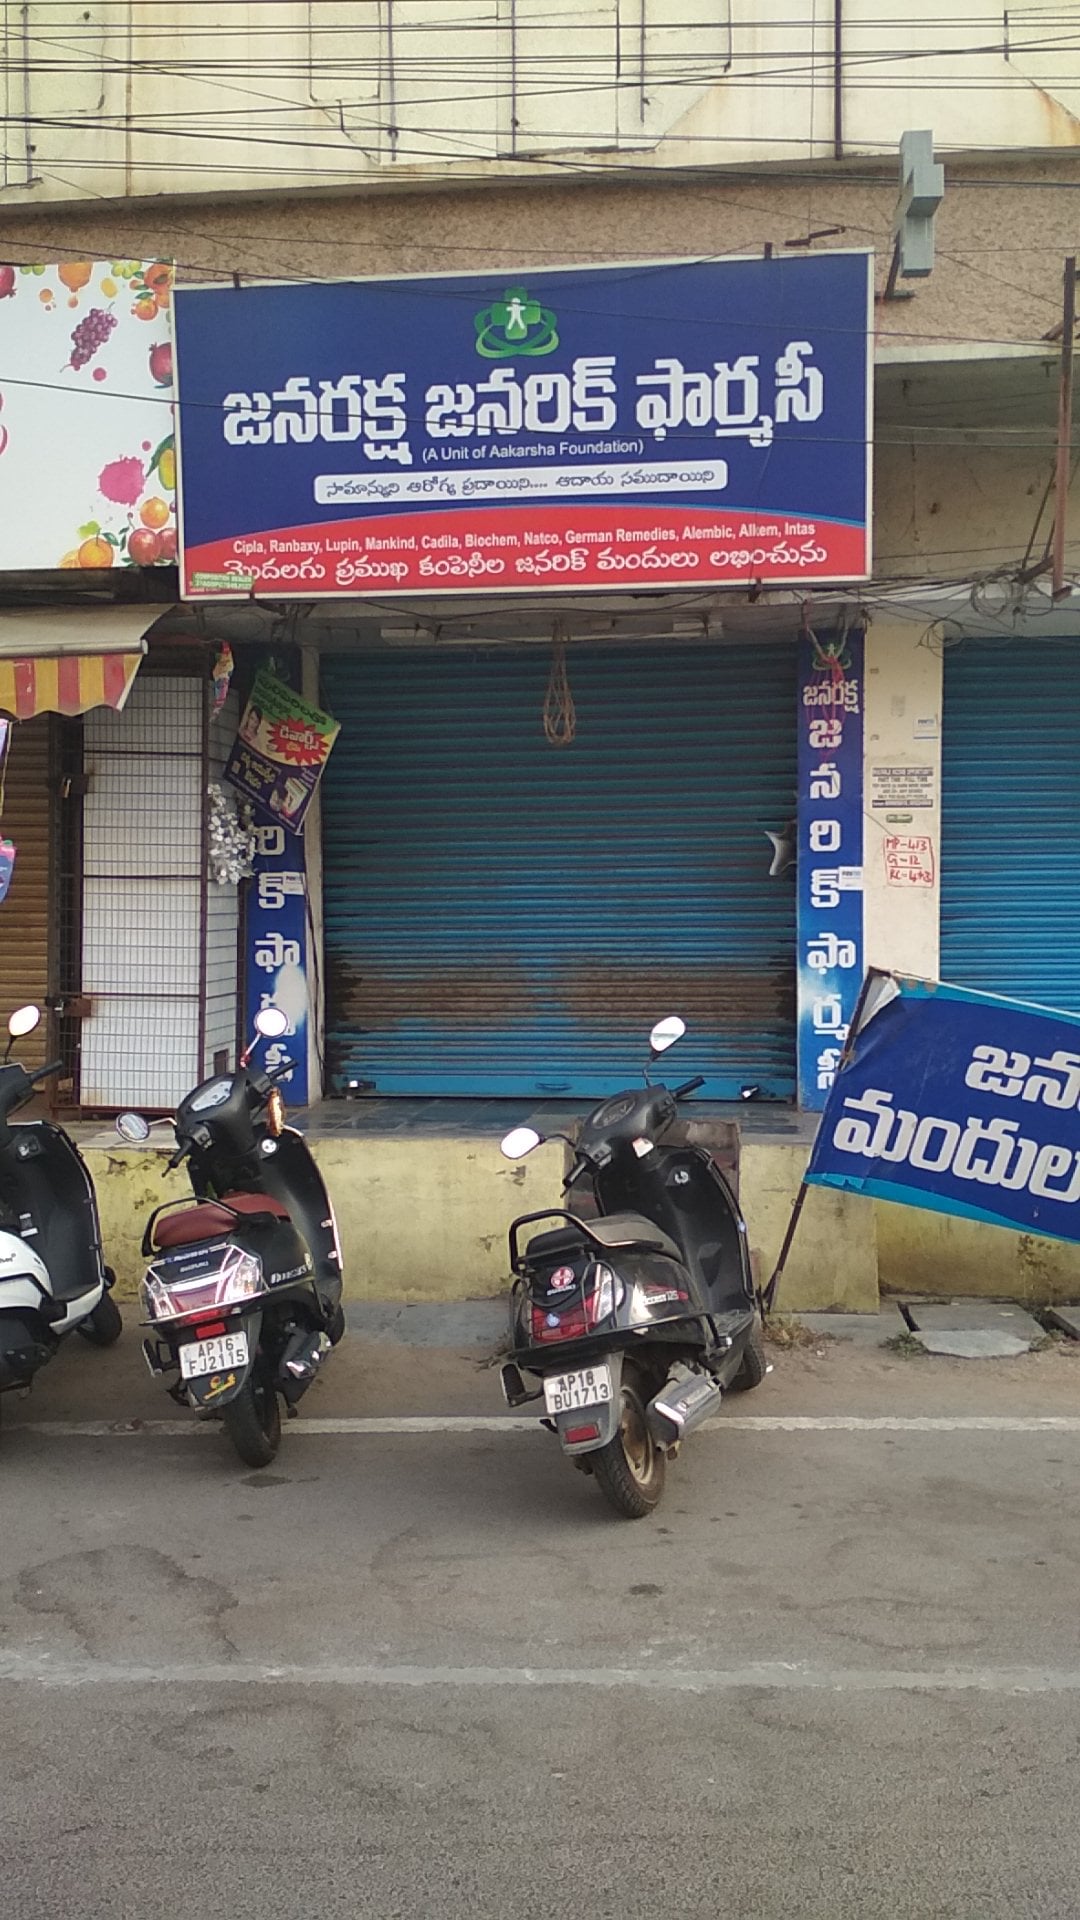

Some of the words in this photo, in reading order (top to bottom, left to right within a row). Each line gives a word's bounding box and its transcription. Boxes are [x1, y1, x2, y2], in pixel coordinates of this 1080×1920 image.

[223, 373, 413, 465] జనరక్ష
[424, 356, 617, 438] జనరిక్
[636, 341, 823, 447] ఫార్మసీ
[441, 447, 468, 461] Unit
[472, 445, 487, 458] of
[489, 443, 556, 458] Aakarsha
[559, 439, 644, 455] Foundation)
[406, 476, 456, 495] ఆరోగ్య
[555, 471, 614, 487] ఆదాయ
[233, 540, 267, 555] Cipla,
[269, 539, 322, 555] Ranbaxy,
[325, 537, 362, 553] Lupin,
[365, 536, 418, 551] Mankind,
[421, 534, 462, 549] Cadila,
[465, 533, 520, 548] Biochem,
[524, 531, 562, 545] Natco,
[565, 530, 612, 544] German
[616, 526, 680, 542] Remedies,
[683, 525, 735, 539] Alembic,
[739, 523, 781, 537] Alkem,
[785, 522, 815, 535] Intas
[336, 555, 409, 586] ప్రముఖ
[515, 548, 589, 575] జనరిక్
[597, 546, 699, 570] మందులు
[710, 540, 828, 568] లభించును
[198, 1337, 234, 1358] AP16
[189, 1349, 245, 1376] FJ2115
[554, 1383, 609, 1410] BU1713
